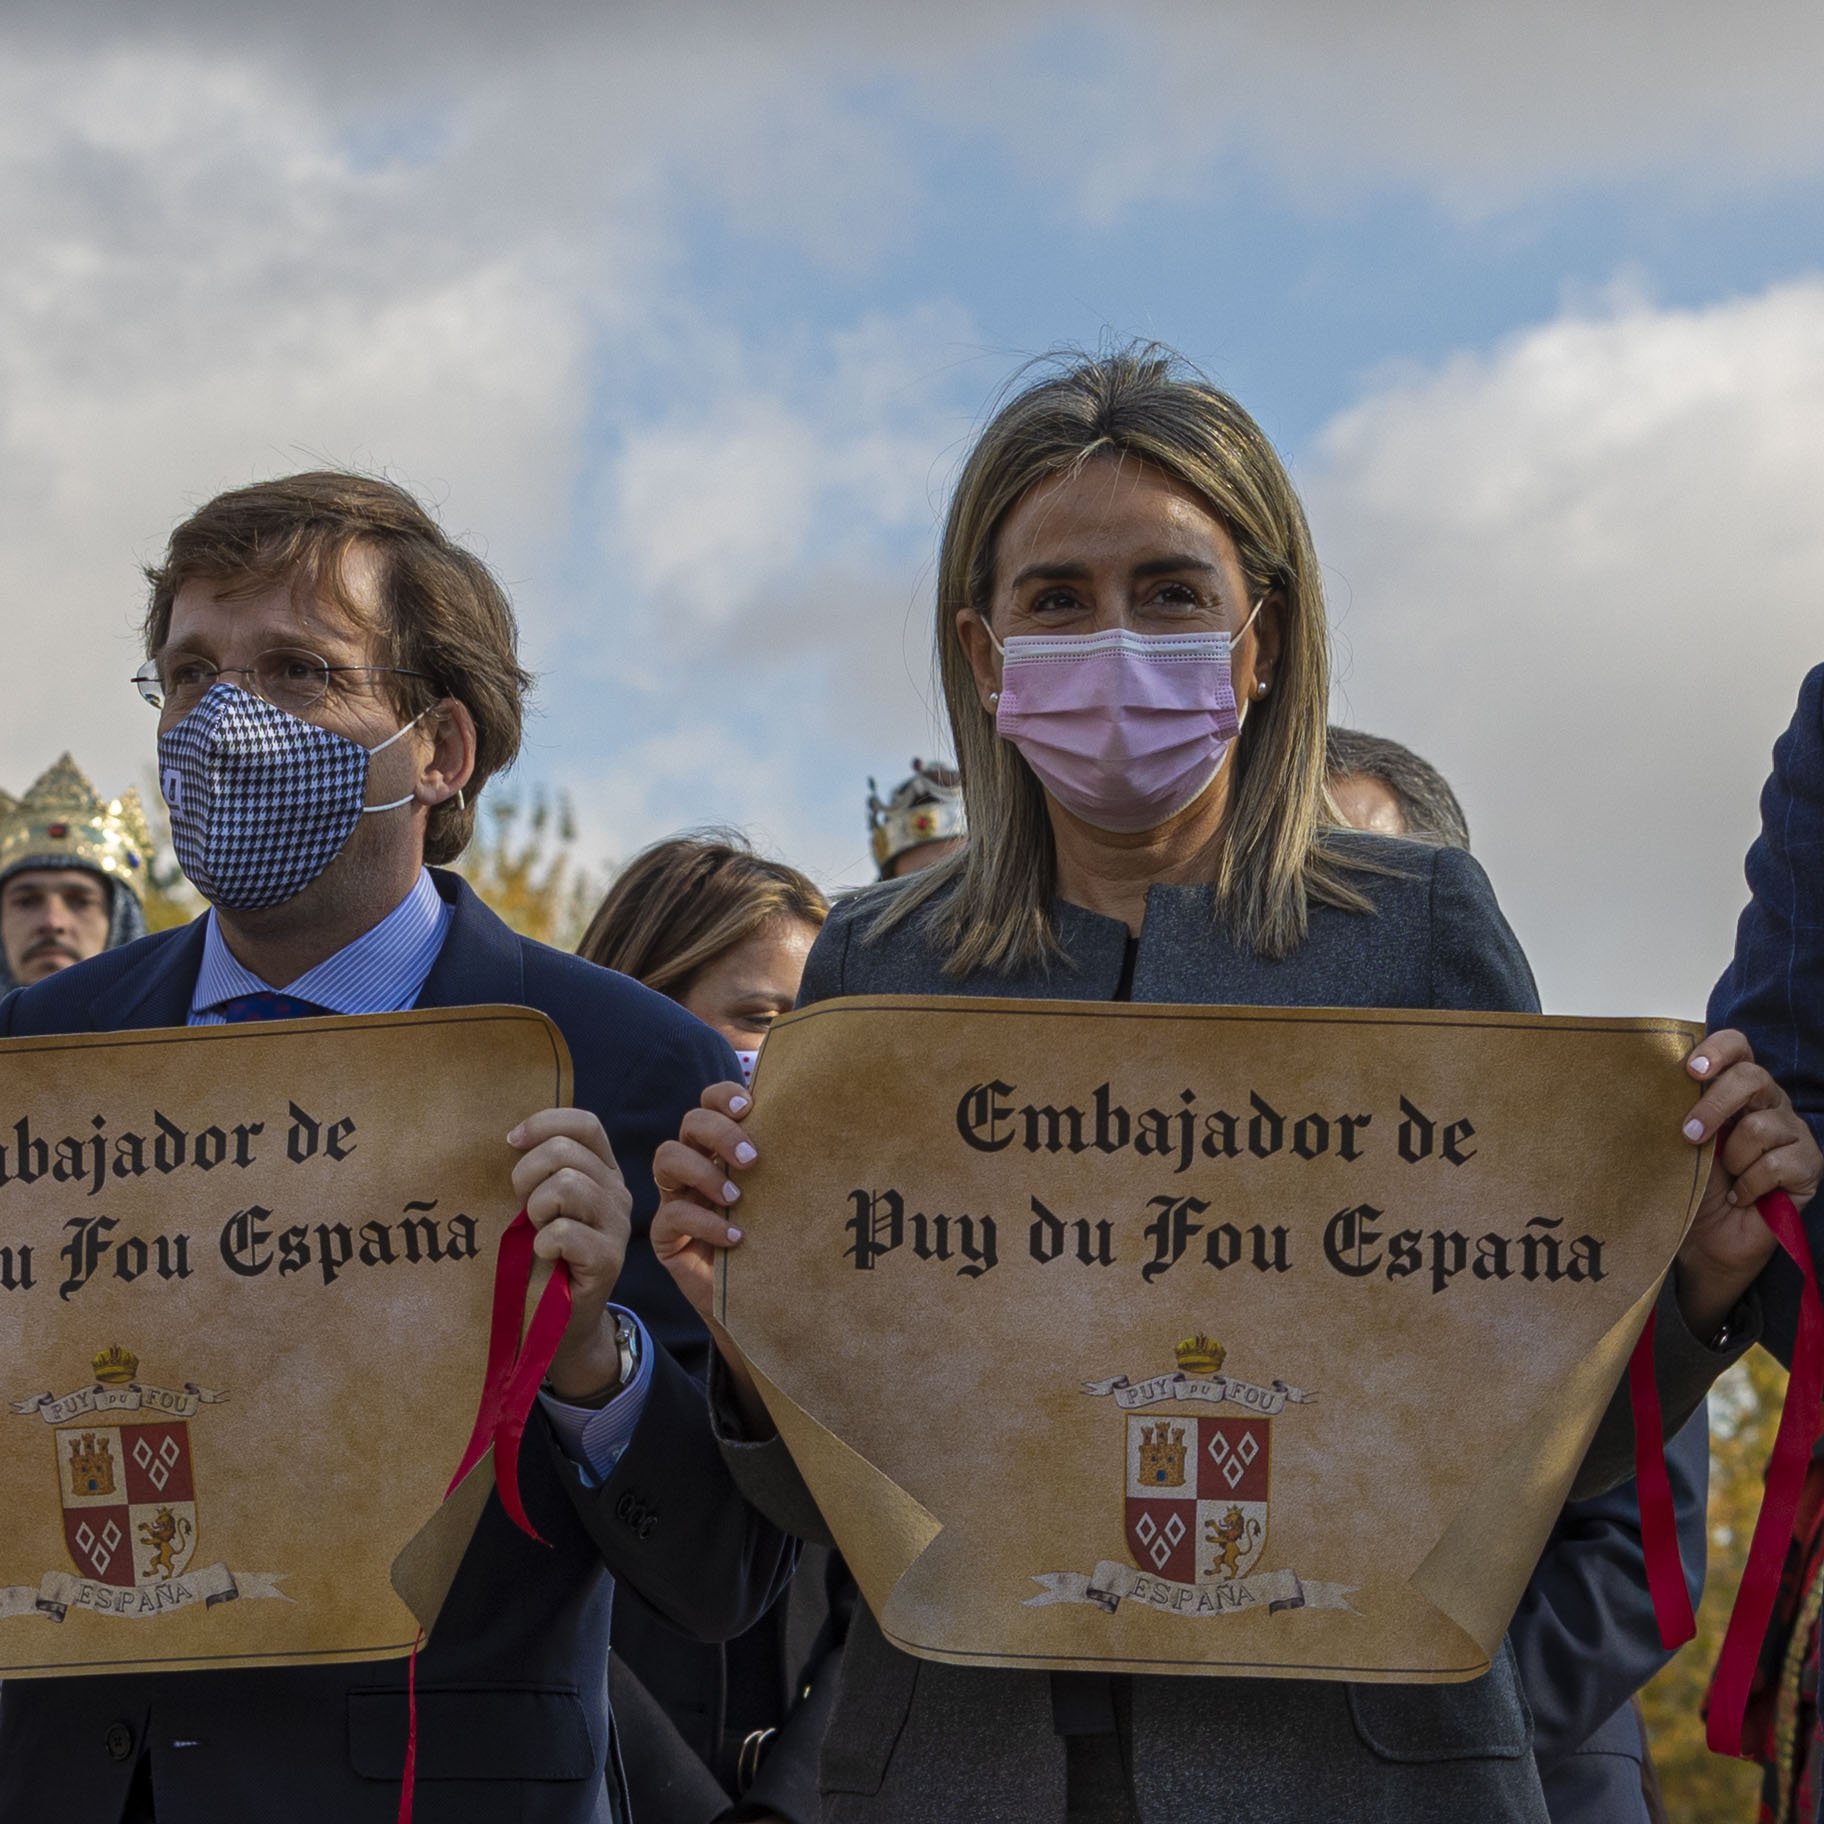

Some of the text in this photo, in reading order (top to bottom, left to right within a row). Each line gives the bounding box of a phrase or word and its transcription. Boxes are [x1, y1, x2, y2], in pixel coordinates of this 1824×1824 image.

[288, 1101, 356, 1163] de
[956, 1079, 1477, 1174] Embajador de
[60, 1216, 193, 1301] Fou
[220, 1200, 480, 1285] España
[843, 1189, 1608, 1294] Puy du Fou España
[51, 1393, 90, 1419] PUY
[145, 1391, 189, 1412] FOU
[1126, 1378, 1169, 1404] PUY
[1229, 1383, 1275, 1409] FOU
[74, 1582, 193, 1612] ESPAÑA
[1130, 1577, 1255, 1611] ESPAÑA
